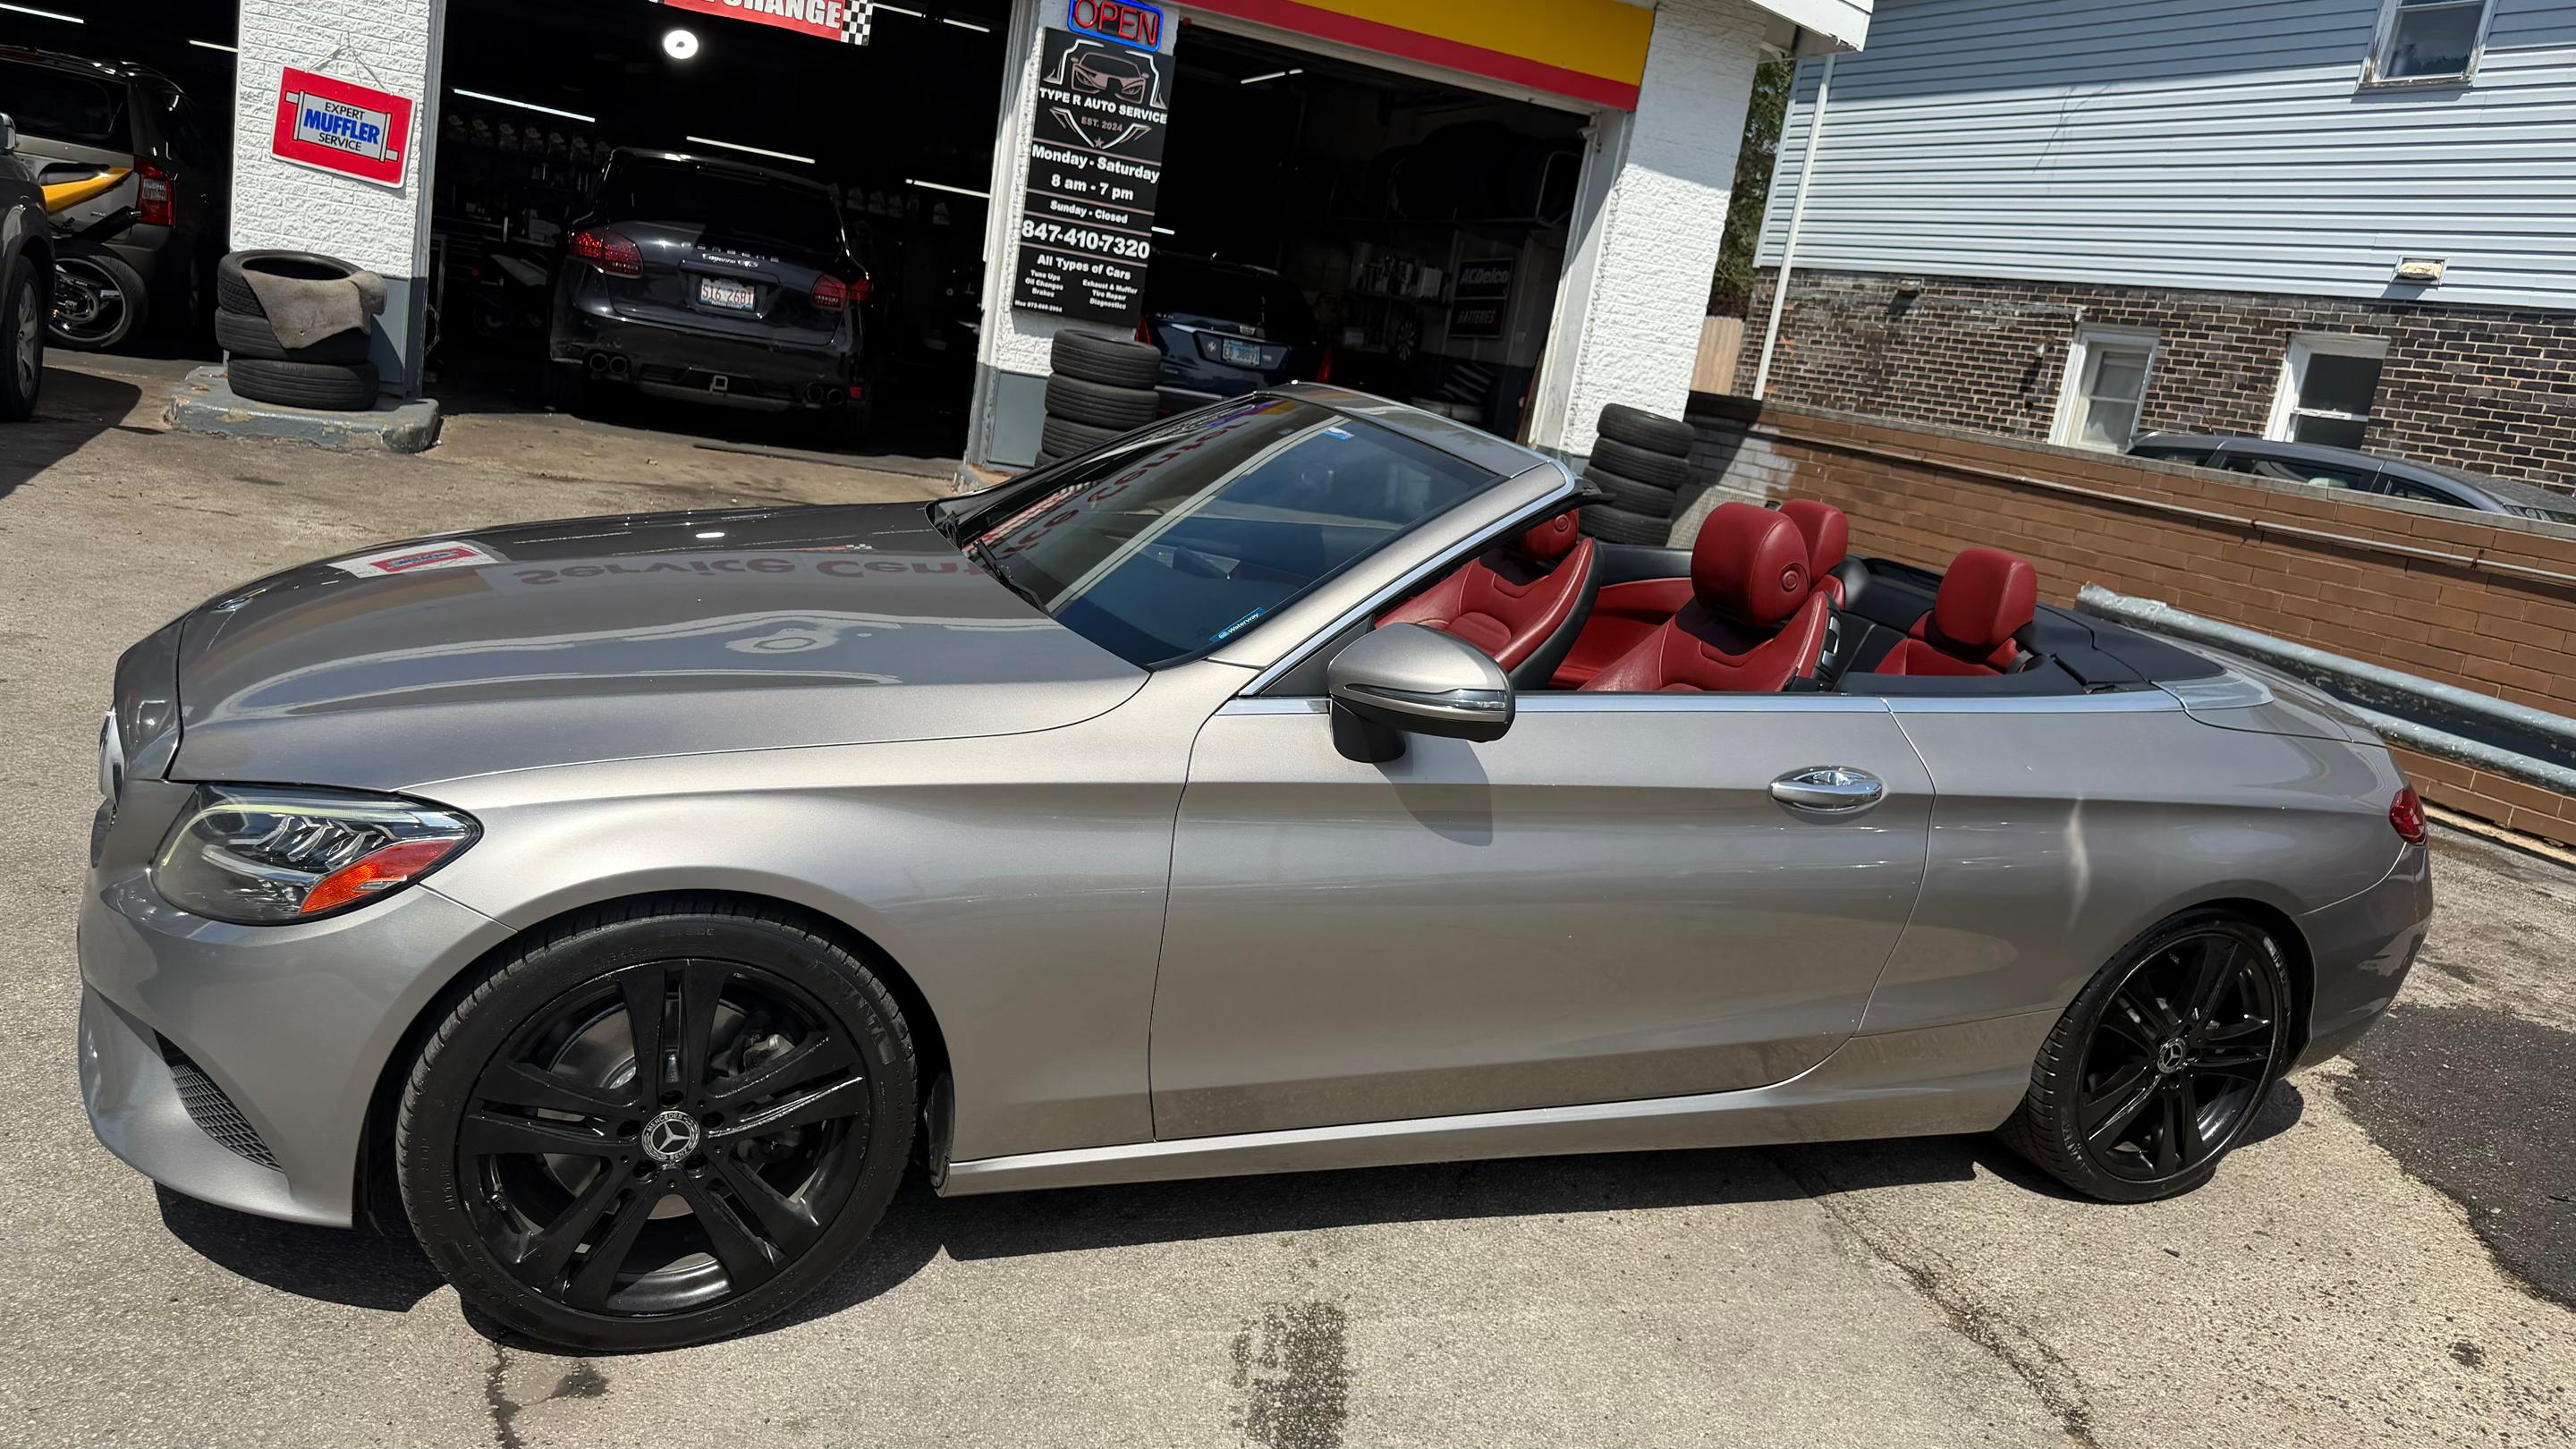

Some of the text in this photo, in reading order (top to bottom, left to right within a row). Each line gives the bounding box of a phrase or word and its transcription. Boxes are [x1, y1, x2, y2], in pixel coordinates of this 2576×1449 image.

[722, 0, 843, 30] ANGE
[1074, 0, 1159, 46] OPEN
[325, 102, 366, 121] EXPERT
[1039, 87, 1167, 124] TYPE R AUTO SERVICE
[303, 108, 380, 145] MUFFLER
[1080, 116, 1123, 132] EST. 2024
[318, 131, 362, 152] SERVICE
[1031, 144, 1088, 169] Monday
[1097, 157, 1160, 183] Saturday
[1051, 174, 1061, 187] 8
[1064, 179, 1087, 192] am
[1099, 182, 1109, 196] 7
[1111, 187, 1134, 201] pm
[1050, 199, 1088, 218] Sunday
[1094, 209, 1129, 224] Closed
[1021, 219, 1151, 259] 847-410-7320
[1030, 269, 1061, 282] Tune Ups
[1037, 254, 1131, 281] All Types of Cars
[1460, 267, 1510, 284] ACDelco
[1025, 276, 1064, 291] Oil Changes
[1031, 287, 1055, 298] Brakes
[1082, 279, 1108, 291] Exhaust
[1115, 284, 1138, 295] Muffler
[1092, 289, 1106, 298] Tire
[1089, 297, 1127, 310] Diagnostics
[1227, 612, 1259, 634] Waterway
[646, 1113, 683, 1132] MERCEDES
[669, 1148, 690, 1161] BENZ
